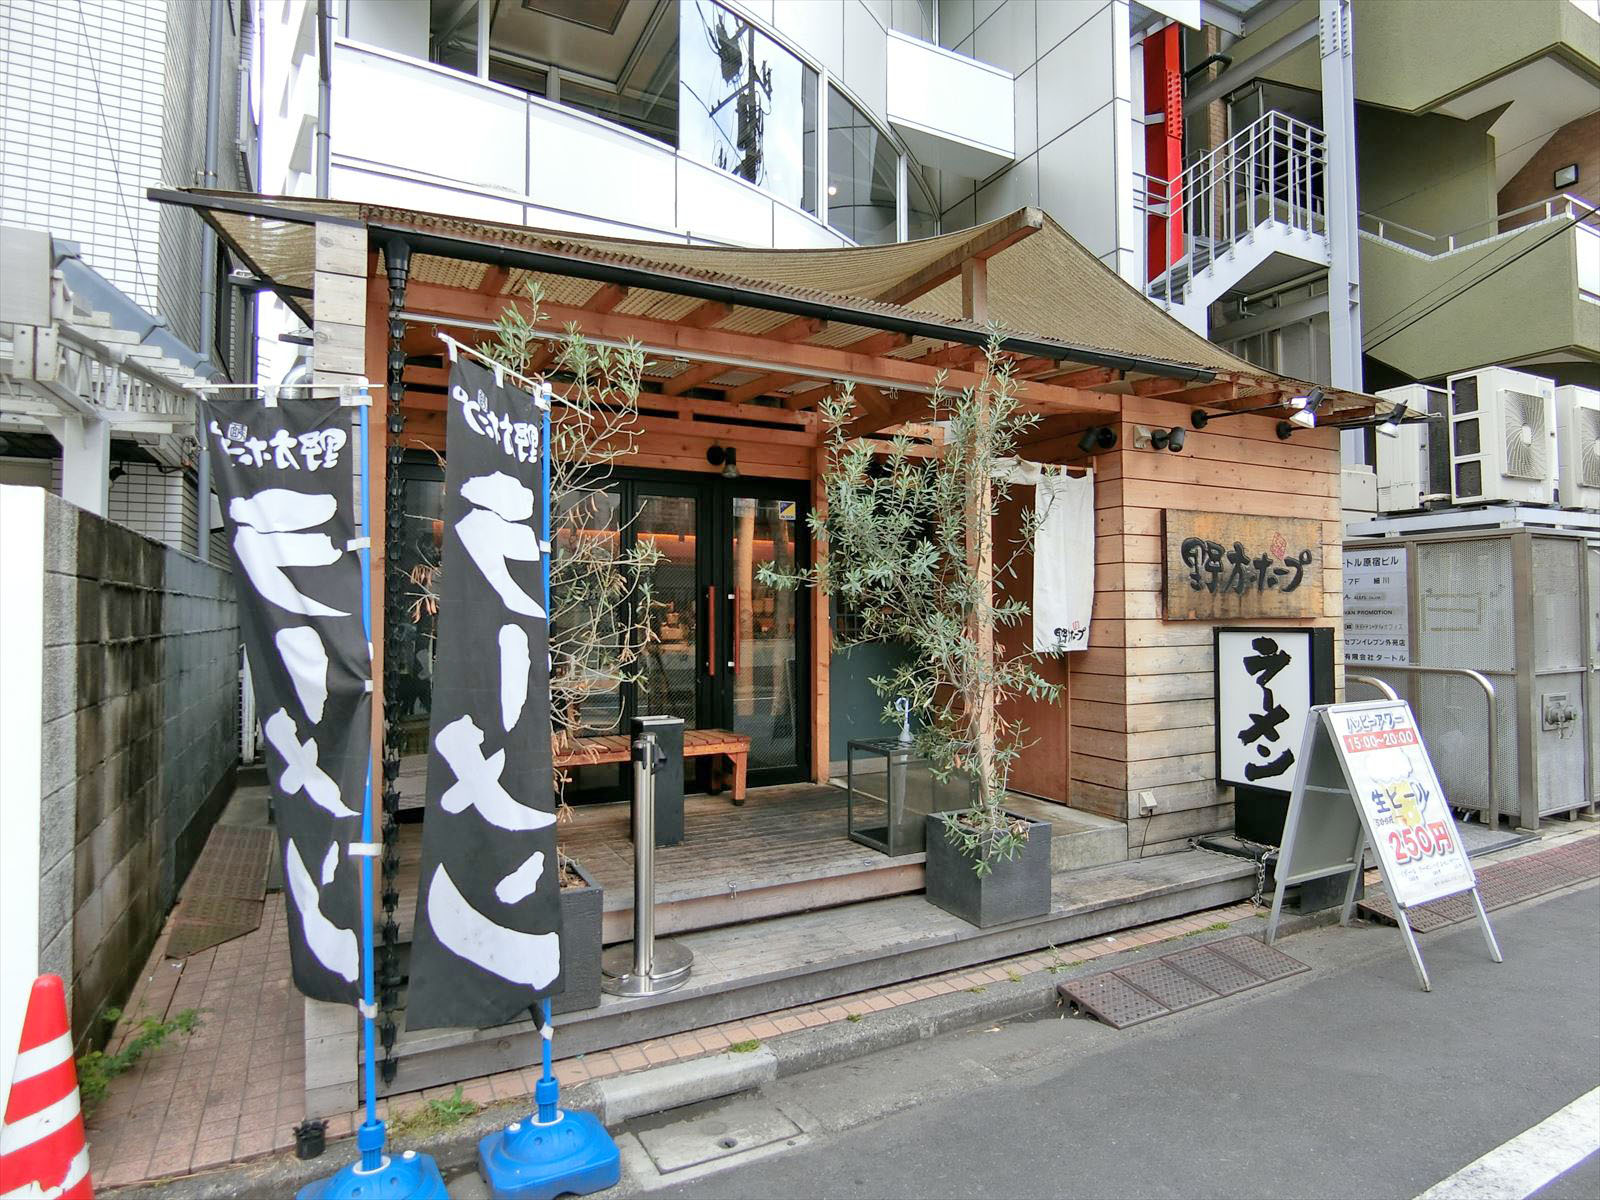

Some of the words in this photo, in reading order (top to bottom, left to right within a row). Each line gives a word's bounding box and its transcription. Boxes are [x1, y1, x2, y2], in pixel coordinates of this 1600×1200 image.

[1181, 536, 1313, 594] 野方ホープ
[1237, 636, 1295, 782] ラーメン
[1346, 713, 1405, 733] ハッピーアワー
[1372, 782, 1430, 814] 生ビール
[1388, 819, 1455, 864] 250円
